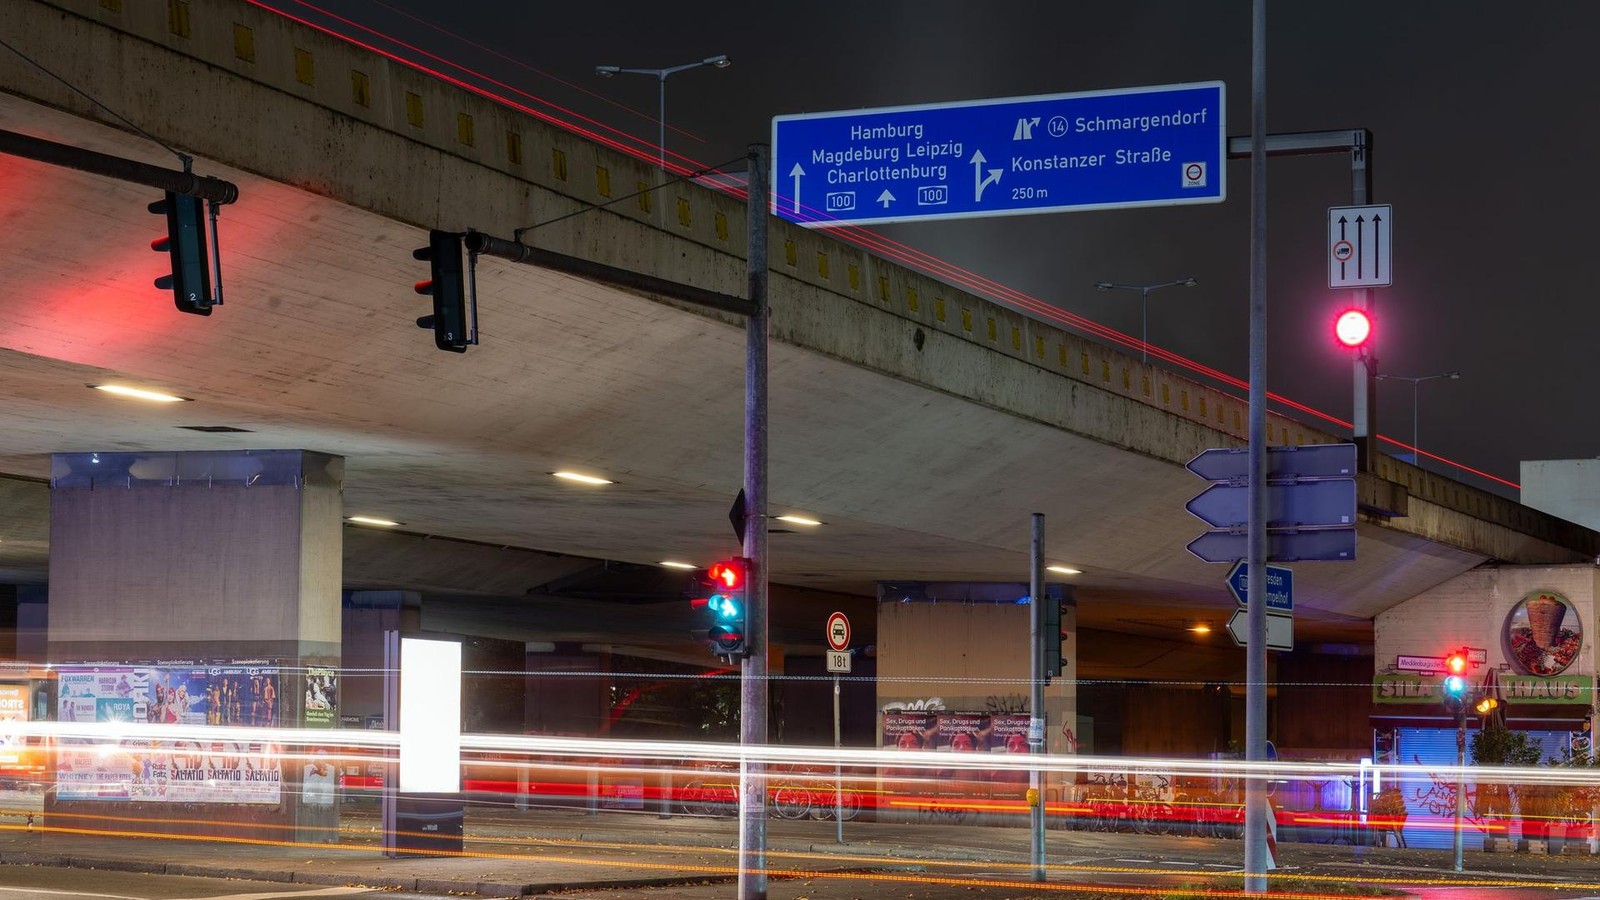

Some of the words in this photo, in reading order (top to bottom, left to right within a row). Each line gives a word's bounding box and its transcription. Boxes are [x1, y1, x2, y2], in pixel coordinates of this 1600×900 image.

[1052, 120, 1066, 133] 14
[1075, 108, 1207, 132] Schmargendorf
[851, 122, 923, 141] Hamburg
[812, 145, 899, 165] Magdeburg
[907, 140, 963, 161] Leipzig
[1011, 152, 1106, 172] Konstanzer
[1115, 147, 1171, 165] Straße
[827, 162, 947, 184] Charlottenburg
[923, 188, 943, 202] 100
[1012, 187, 1035, 200] 250
[1036, 189, 1048, 199] m
[831, 195, 851, 208] 100
[190, 292, 196, 301] 2
[447, 332, 453, 341] 3
[900, 718, 915, 726] Drugs
[940, 718, 951, 726] Sex,
[952, 718, 969, 727] Drugs
[1007, 719, 1024, 727] Drugs
[170, 769, 204, 781] SALTATIO
[207, 769, 241, 781] SALTATIO
[245, 770, 279, 782] SALTATIO
